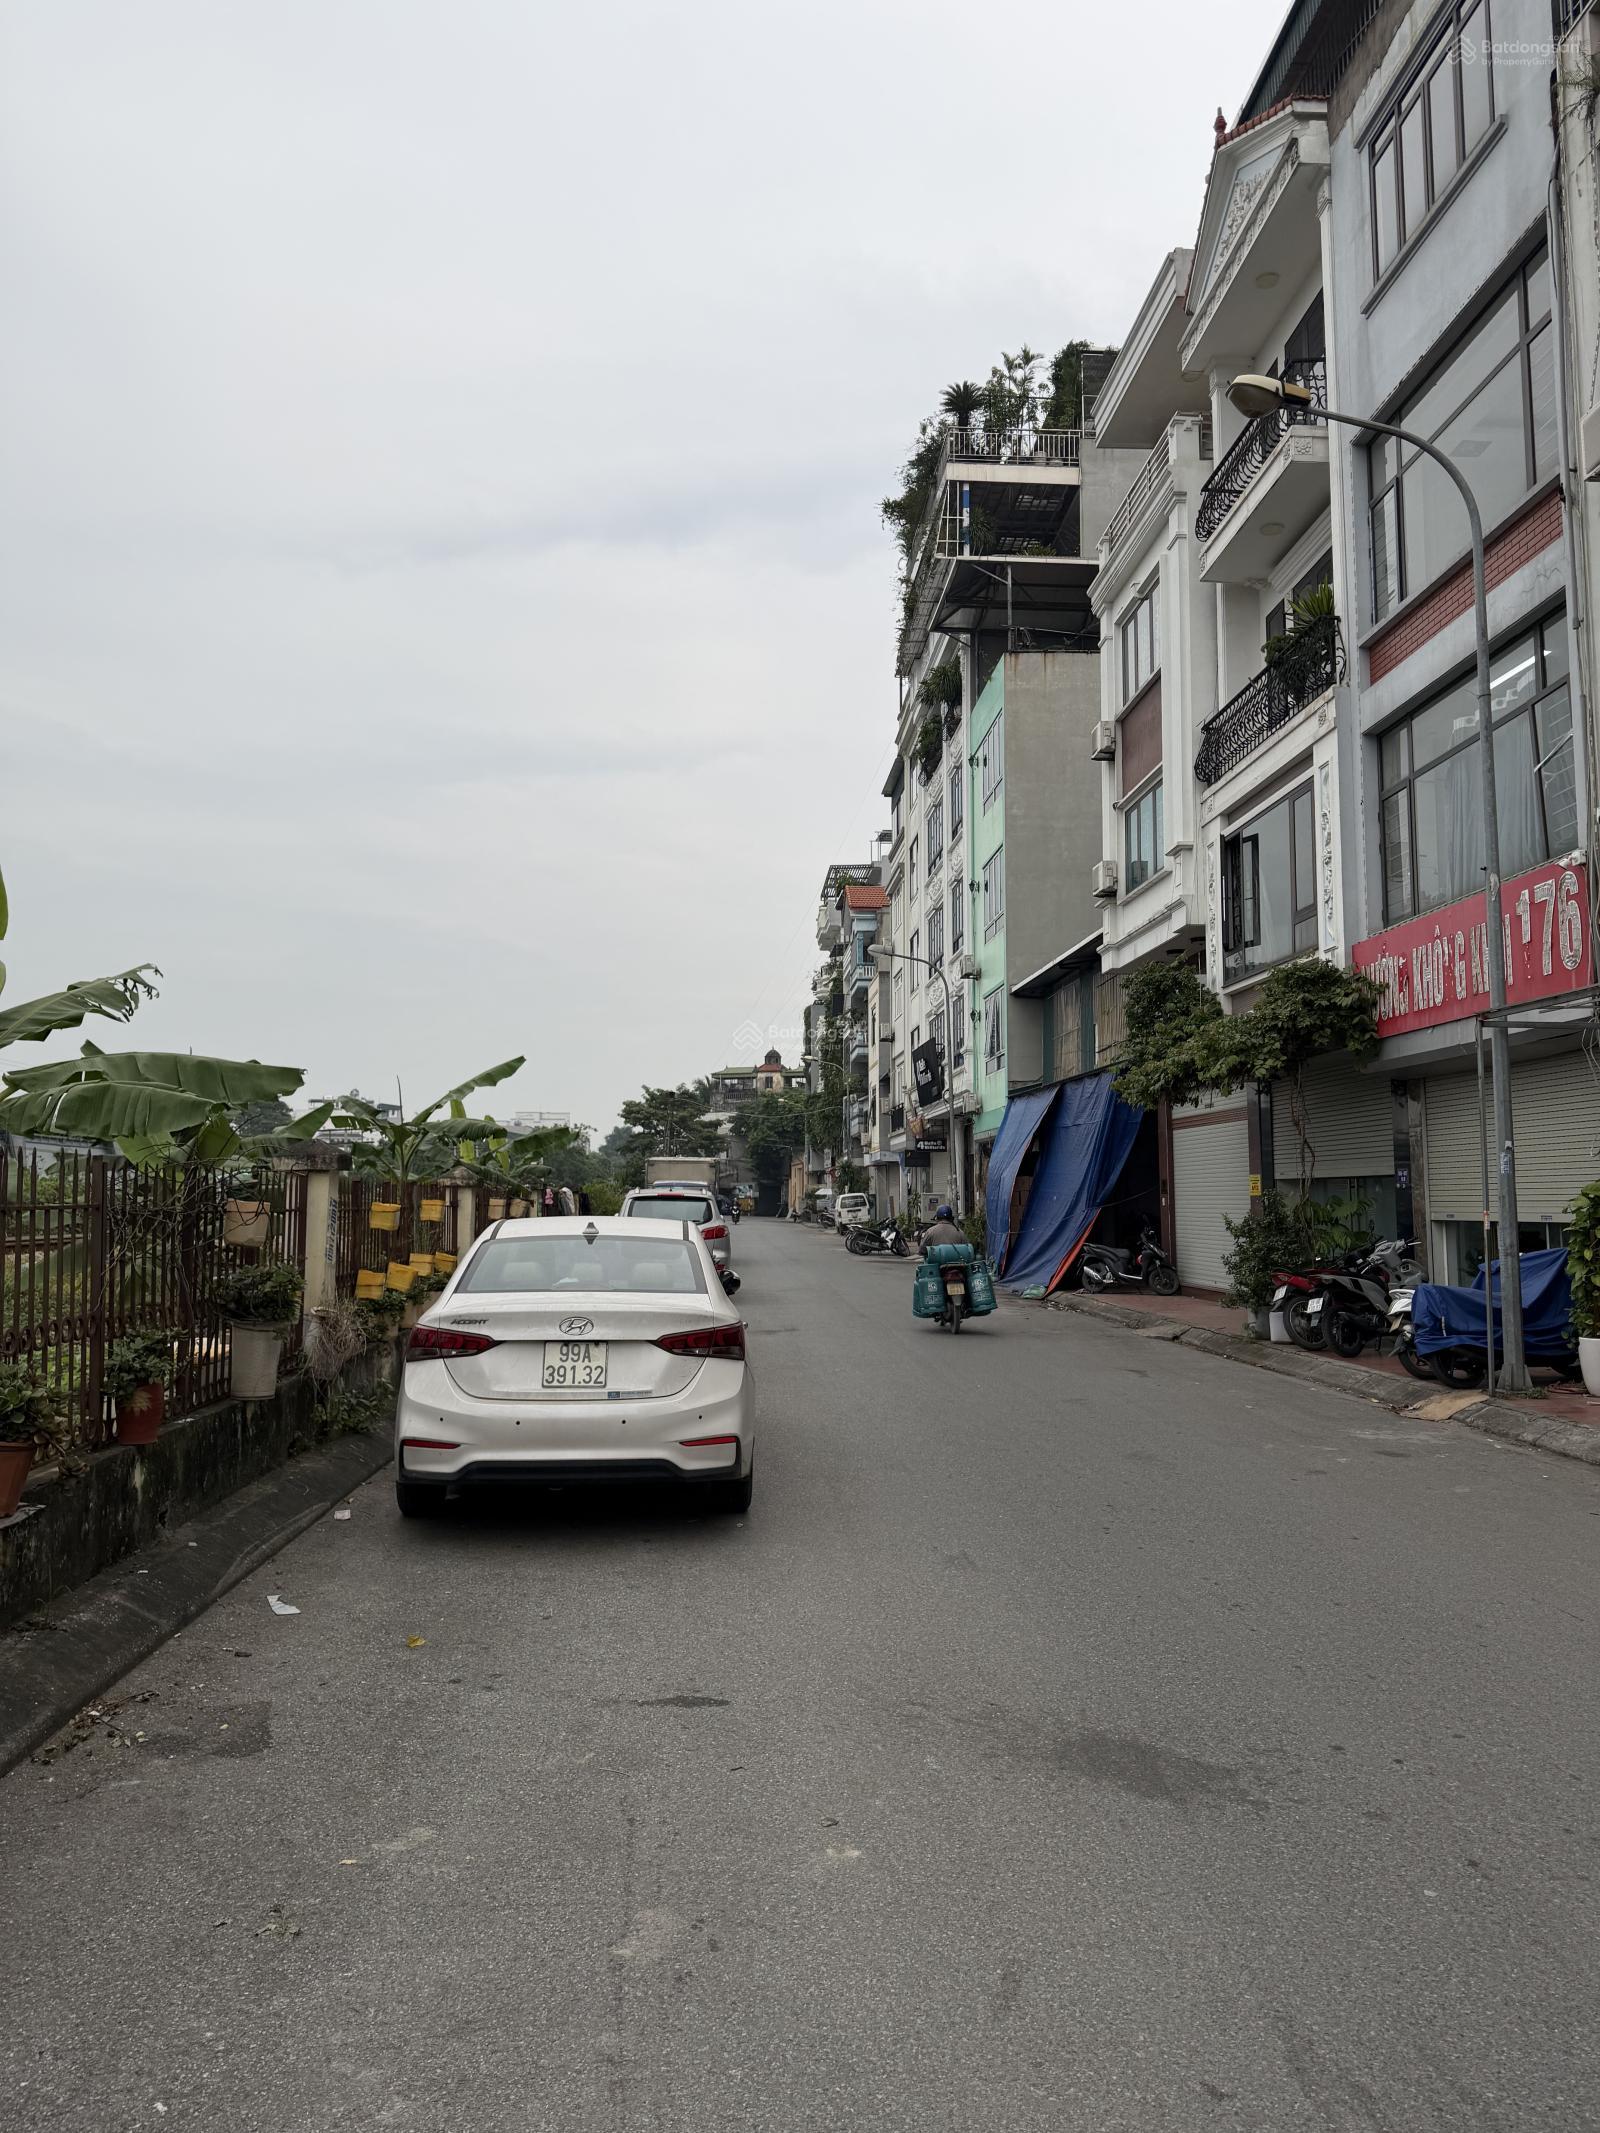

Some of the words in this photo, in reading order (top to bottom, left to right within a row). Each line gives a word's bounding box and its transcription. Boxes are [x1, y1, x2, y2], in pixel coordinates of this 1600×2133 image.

[1516, 871, 1583, 976] 176
[559, 1343, 591, 1363] 99A
[544, 1365, 604, 1385] 391.32
